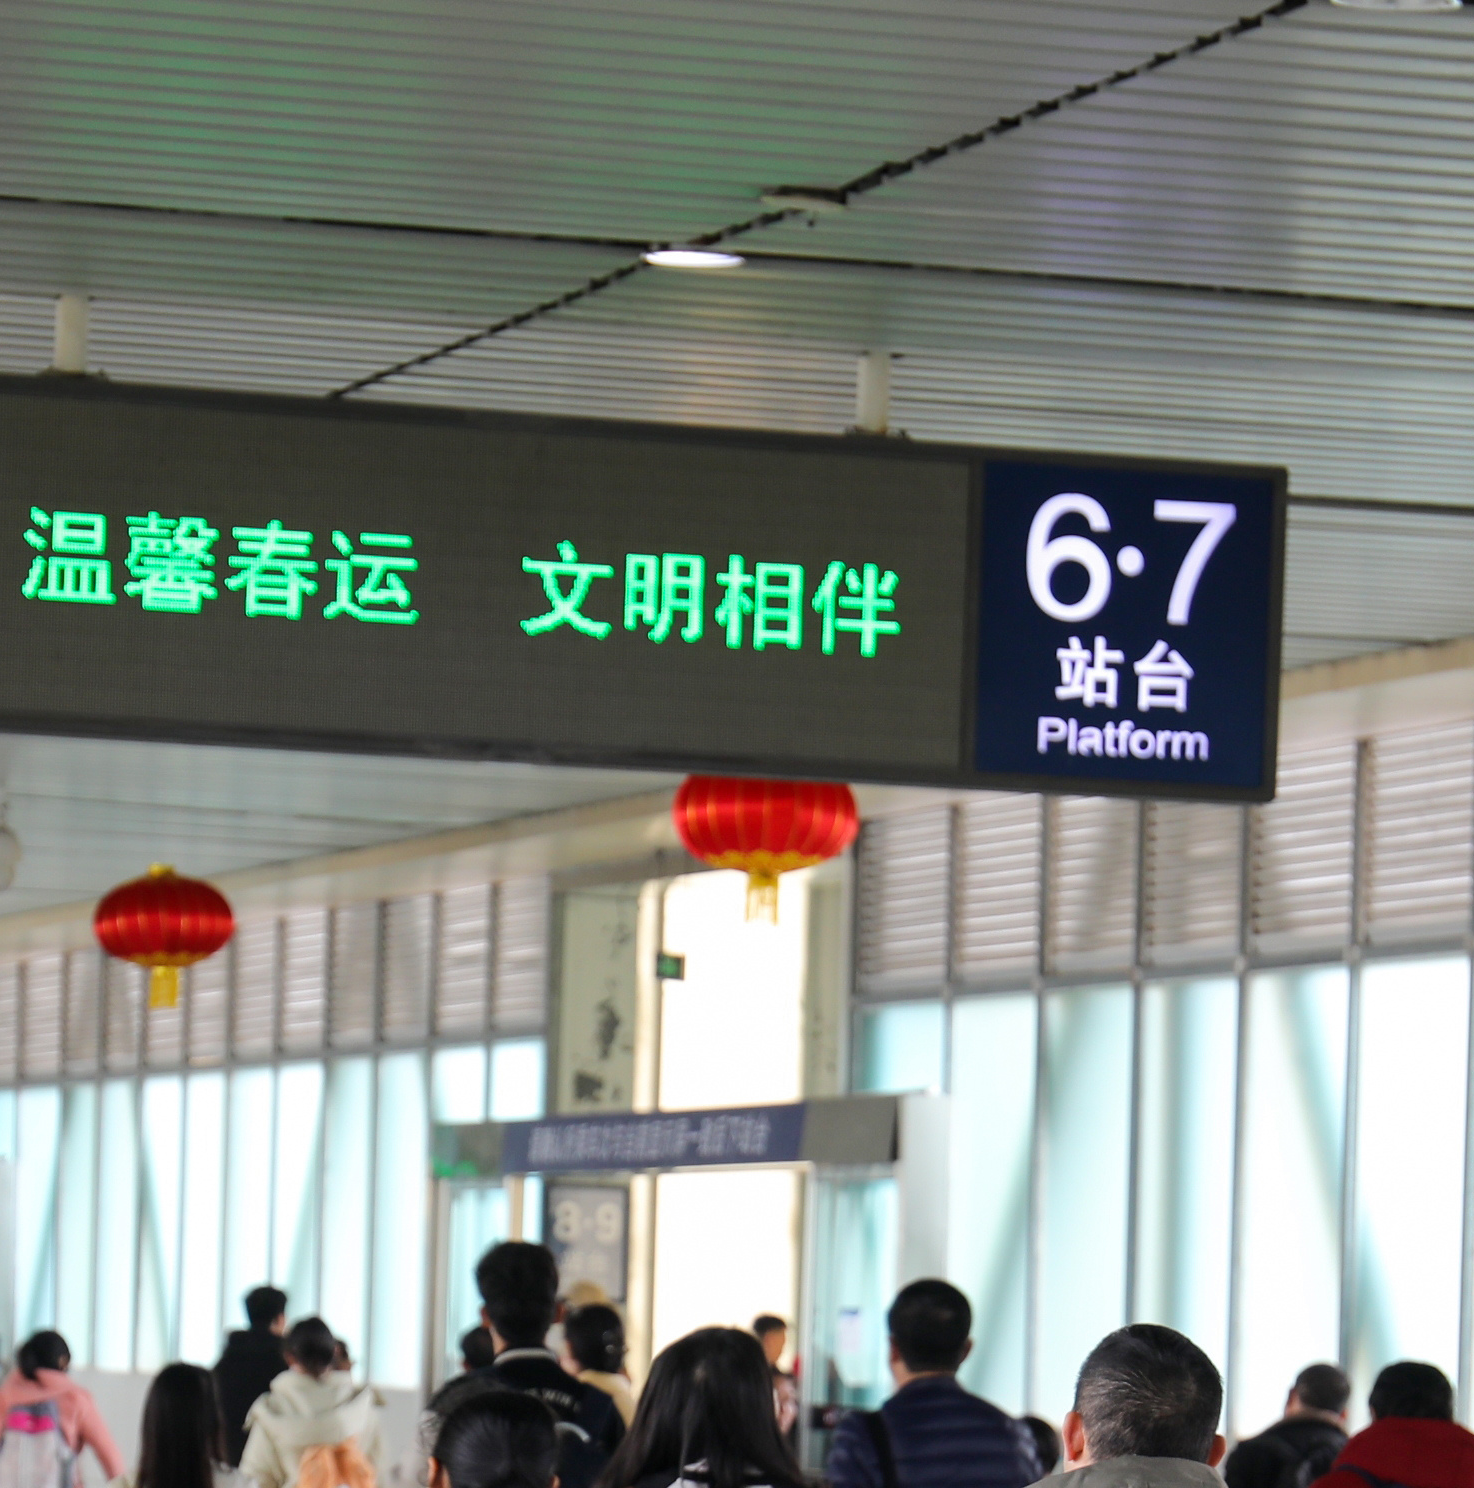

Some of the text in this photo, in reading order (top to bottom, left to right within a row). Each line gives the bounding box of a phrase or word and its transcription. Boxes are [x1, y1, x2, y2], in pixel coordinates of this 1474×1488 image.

[21, 506, 901, 658] 温馨春运 文明相伴
[1054, 635, 1195, 713] 站台
[1036, 716, 1210, 761] Platform
